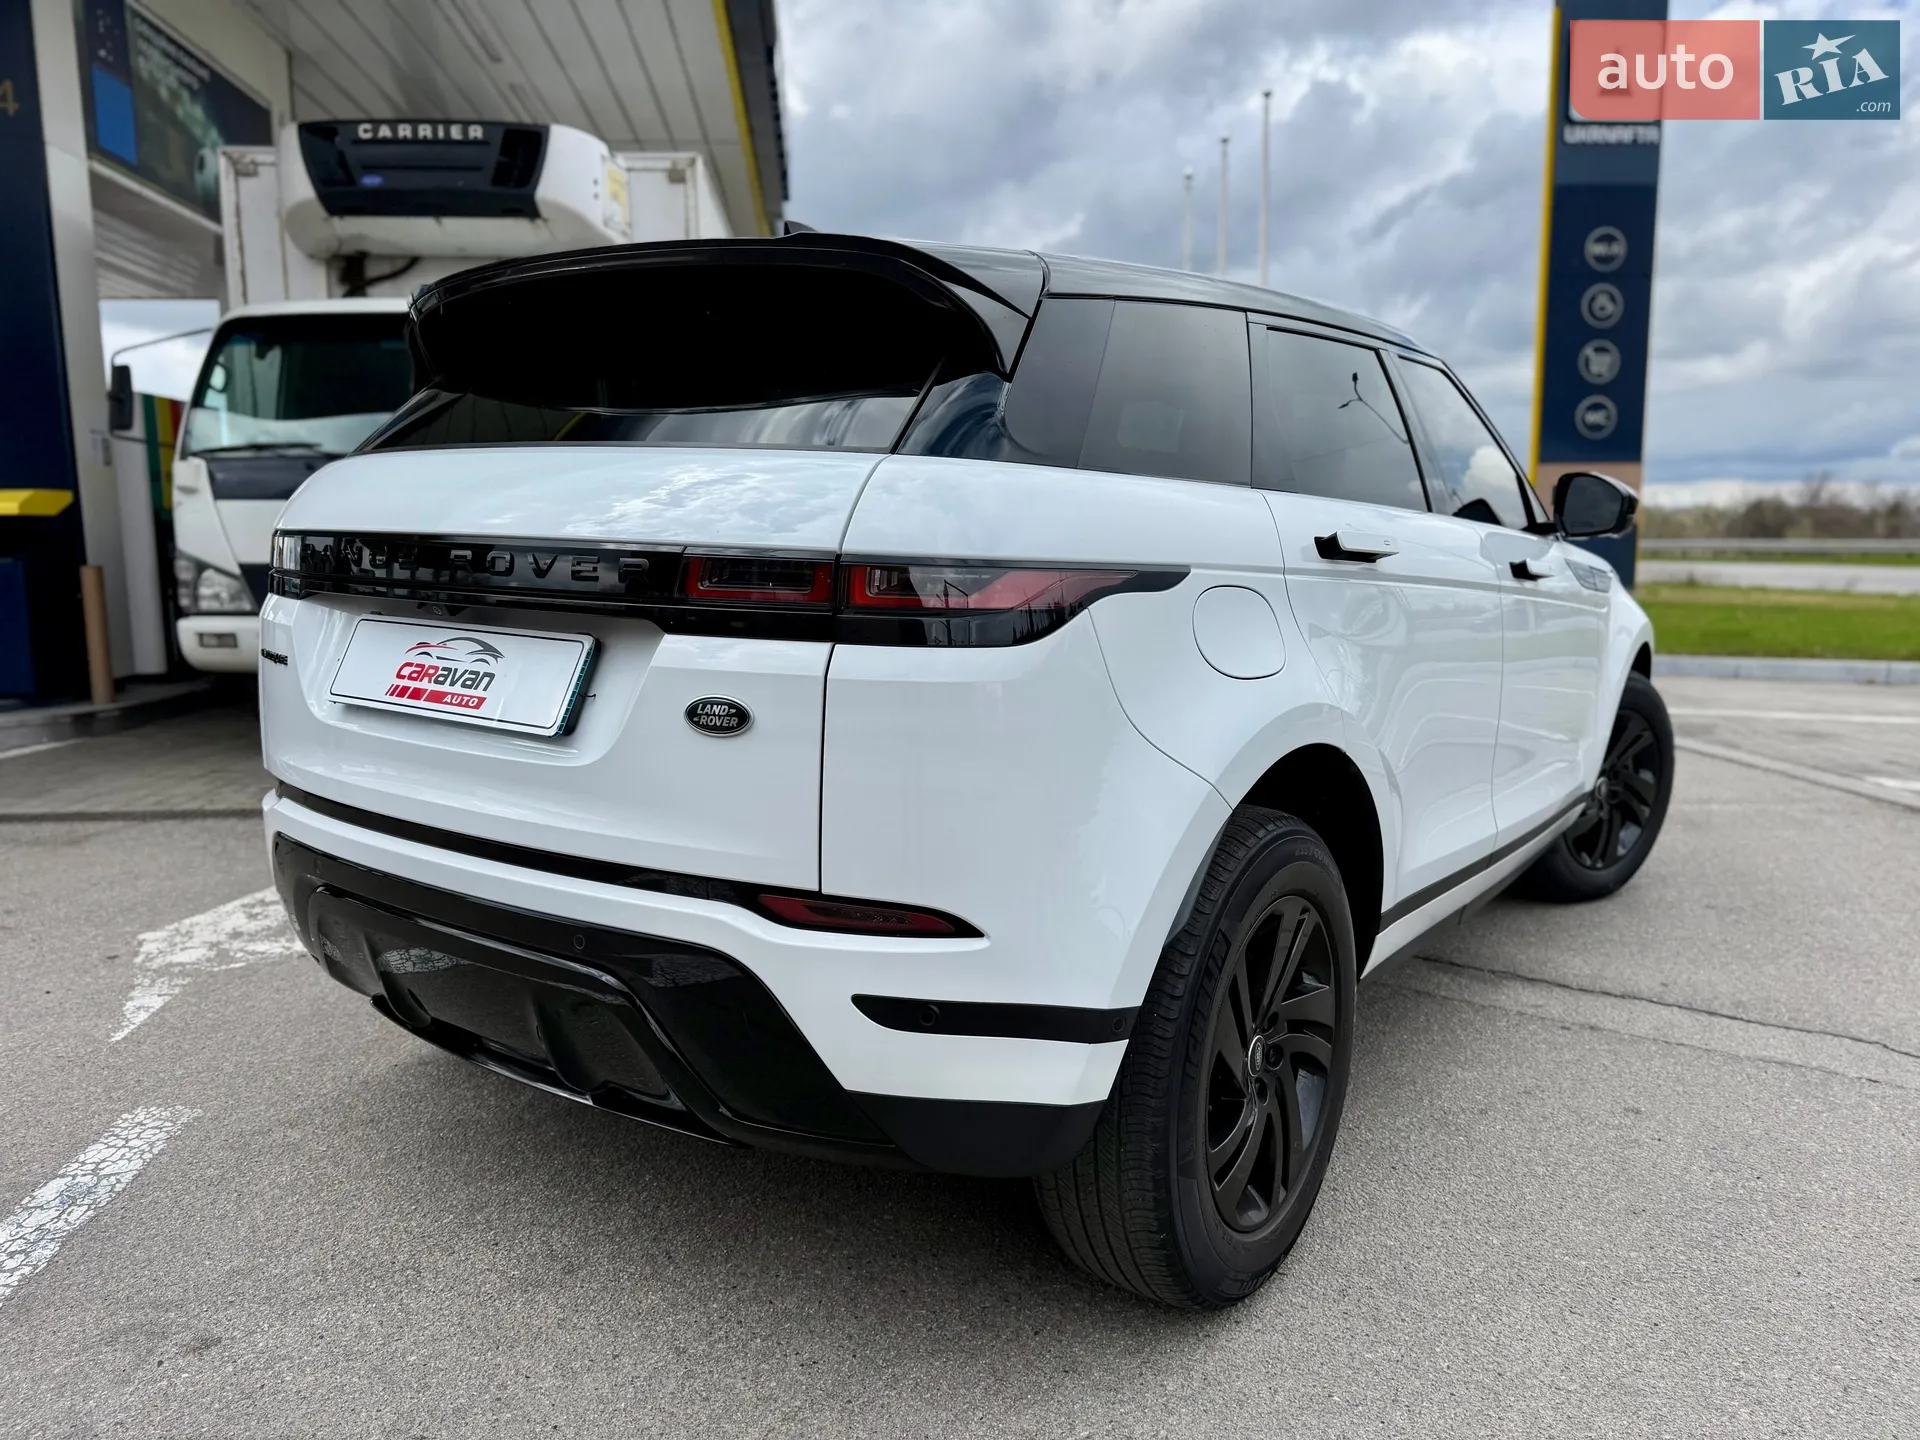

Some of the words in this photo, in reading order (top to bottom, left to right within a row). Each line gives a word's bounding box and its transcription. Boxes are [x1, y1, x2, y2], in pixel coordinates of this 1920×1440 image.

[357, 122, 484, 141] CARRIER
[449, 548, 651, 587] ROVER
[442, 694, 479, 707] AUTO
[696, 703, 729, 716] LAND
[699, 715, 739, 727] ROVER
